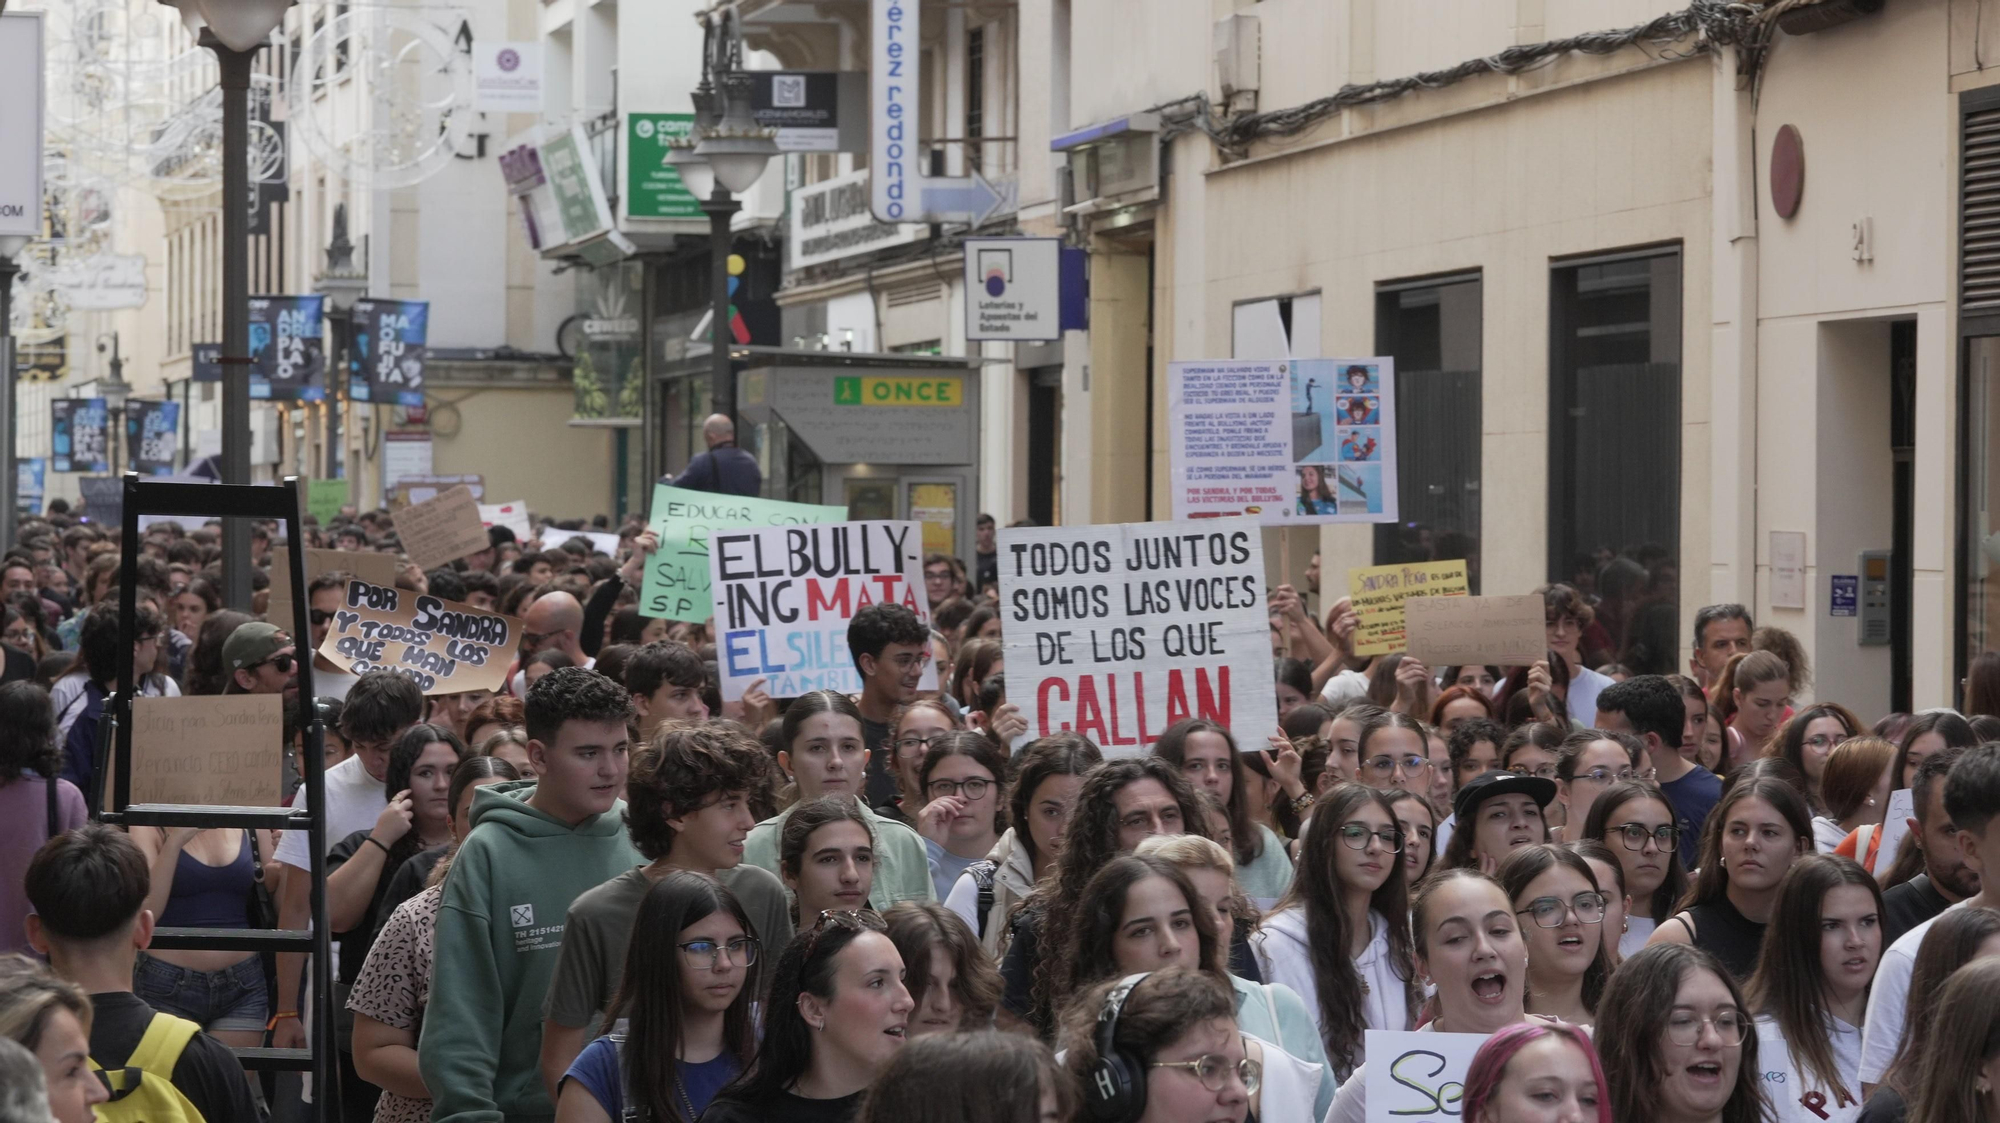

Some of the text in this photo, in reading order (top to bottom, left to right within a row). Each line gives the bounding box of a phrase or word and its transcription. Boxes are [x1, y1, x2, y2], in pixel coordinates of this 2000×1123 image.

[887, 86, 903, 219] redondo
[0, 204, 24, 217] OM
[980, 312, 1038, 322] Apuestas del
[980, 324, 1011, 333] Estado
[872, 381, 952, 401] ONCE
[668, 502, 752, 521] EDUCAR
[717, 534, 784, 581] EL
[1010, 531, 1250, 577] TODOS JUNTOS
[347, 580, 509, 646] POR SANDRA
[717, 580, 800, 630] -ING
[1012, 575, 1256, 622] SOMOS LAS VOCES
[335, 636, 387, 662] QUE
[336, 611, 489, 667] Y TODOS LOS
[724, 629, 857, 678] EL SILE
[1036, 621, 1226, 665] DE LOS QUE
[1036, 665, 1232, 747] CALLAN
[514, 925, 565, 939] TH 2151421
